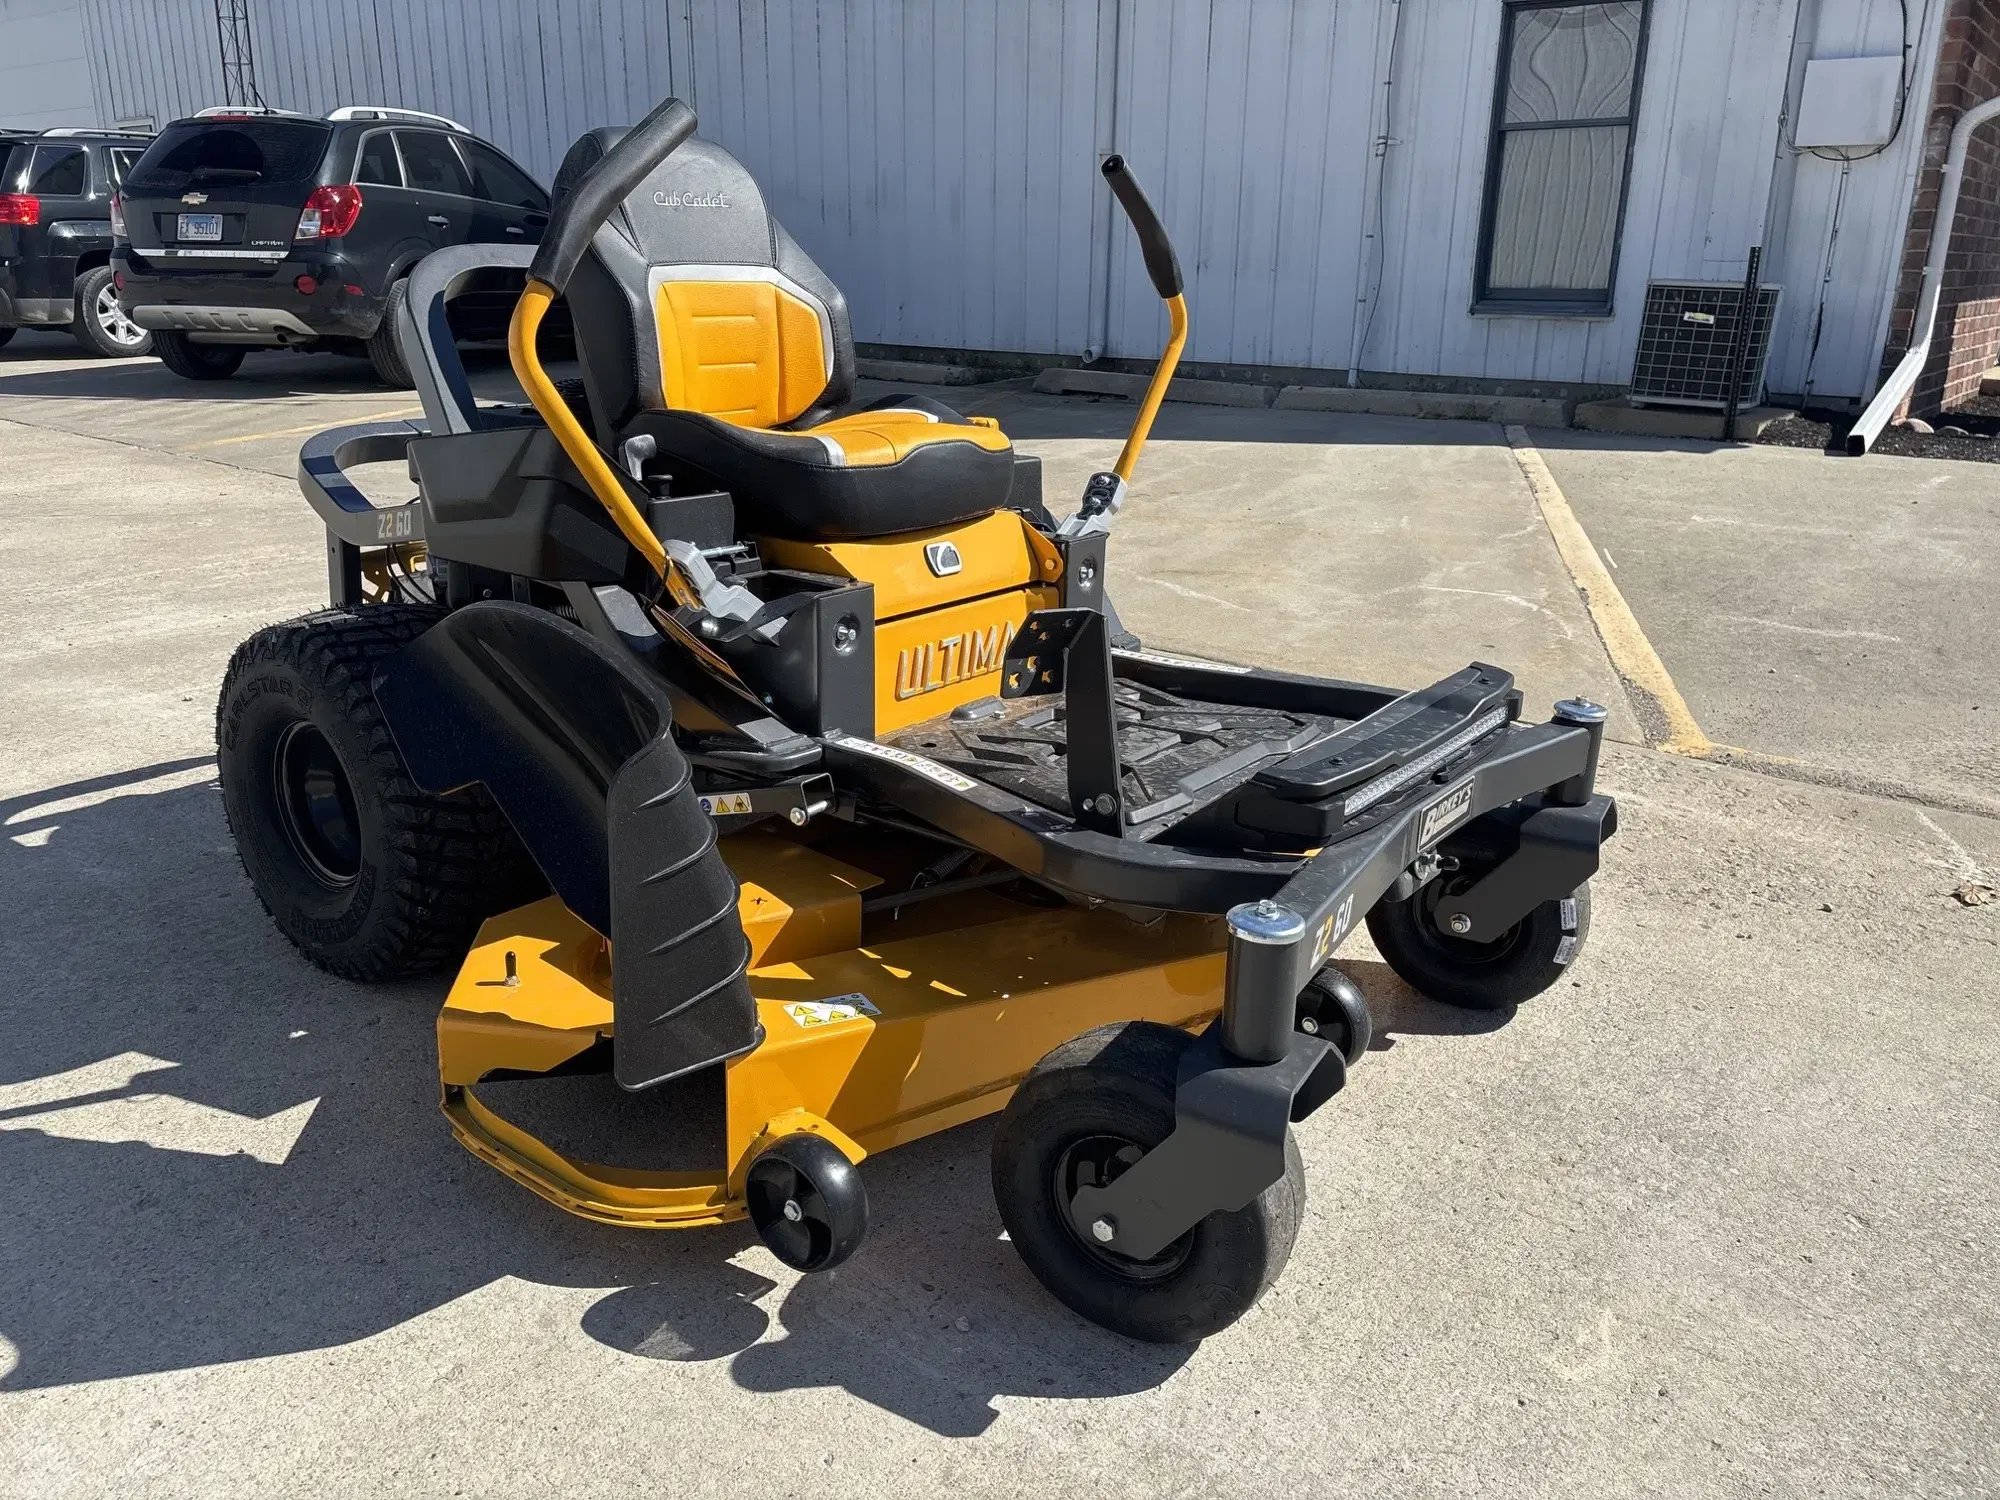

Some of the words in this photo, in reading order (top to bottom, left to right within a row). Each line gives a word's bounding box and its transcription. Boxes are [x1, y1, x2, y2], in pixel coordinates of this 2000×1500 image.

[653, 191, 681, 206] Cub
[682, 192, 730, 208] Cadet
[378, 513, 393, 539] Z2
[396, 510, 411, 537] 60
[1309, 915, 1333, 970] Z2
[1333, 893, 1354, 943] 60
